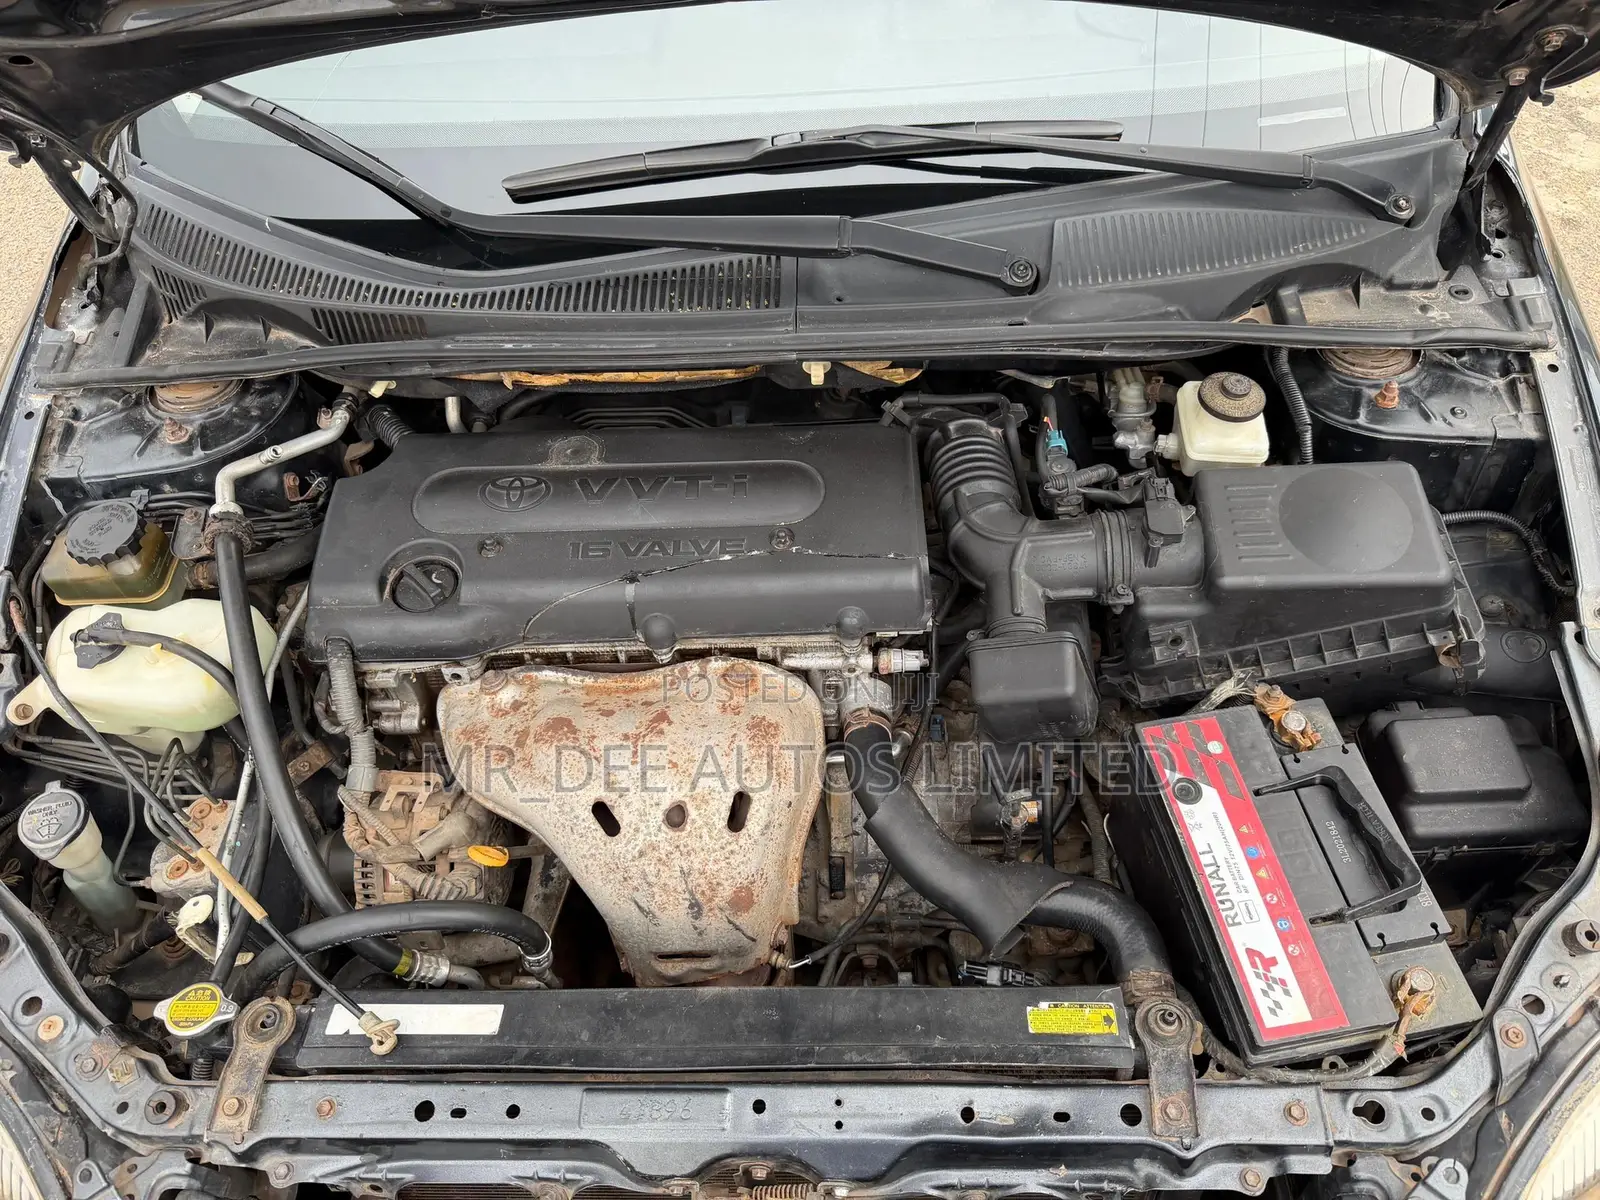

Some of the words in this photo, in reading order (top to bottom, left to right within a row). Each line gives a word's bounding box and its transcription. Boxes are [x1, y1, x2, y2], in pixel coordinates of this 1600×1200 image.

[574, 475, 748, 502] VVT-i
[568, 541, 613, 560] 16
[617, 537, 748, 560] VALVE
[1199, 842, 1243, 928] RUNALL
[220, 1004, 234, 1013] 0.9
